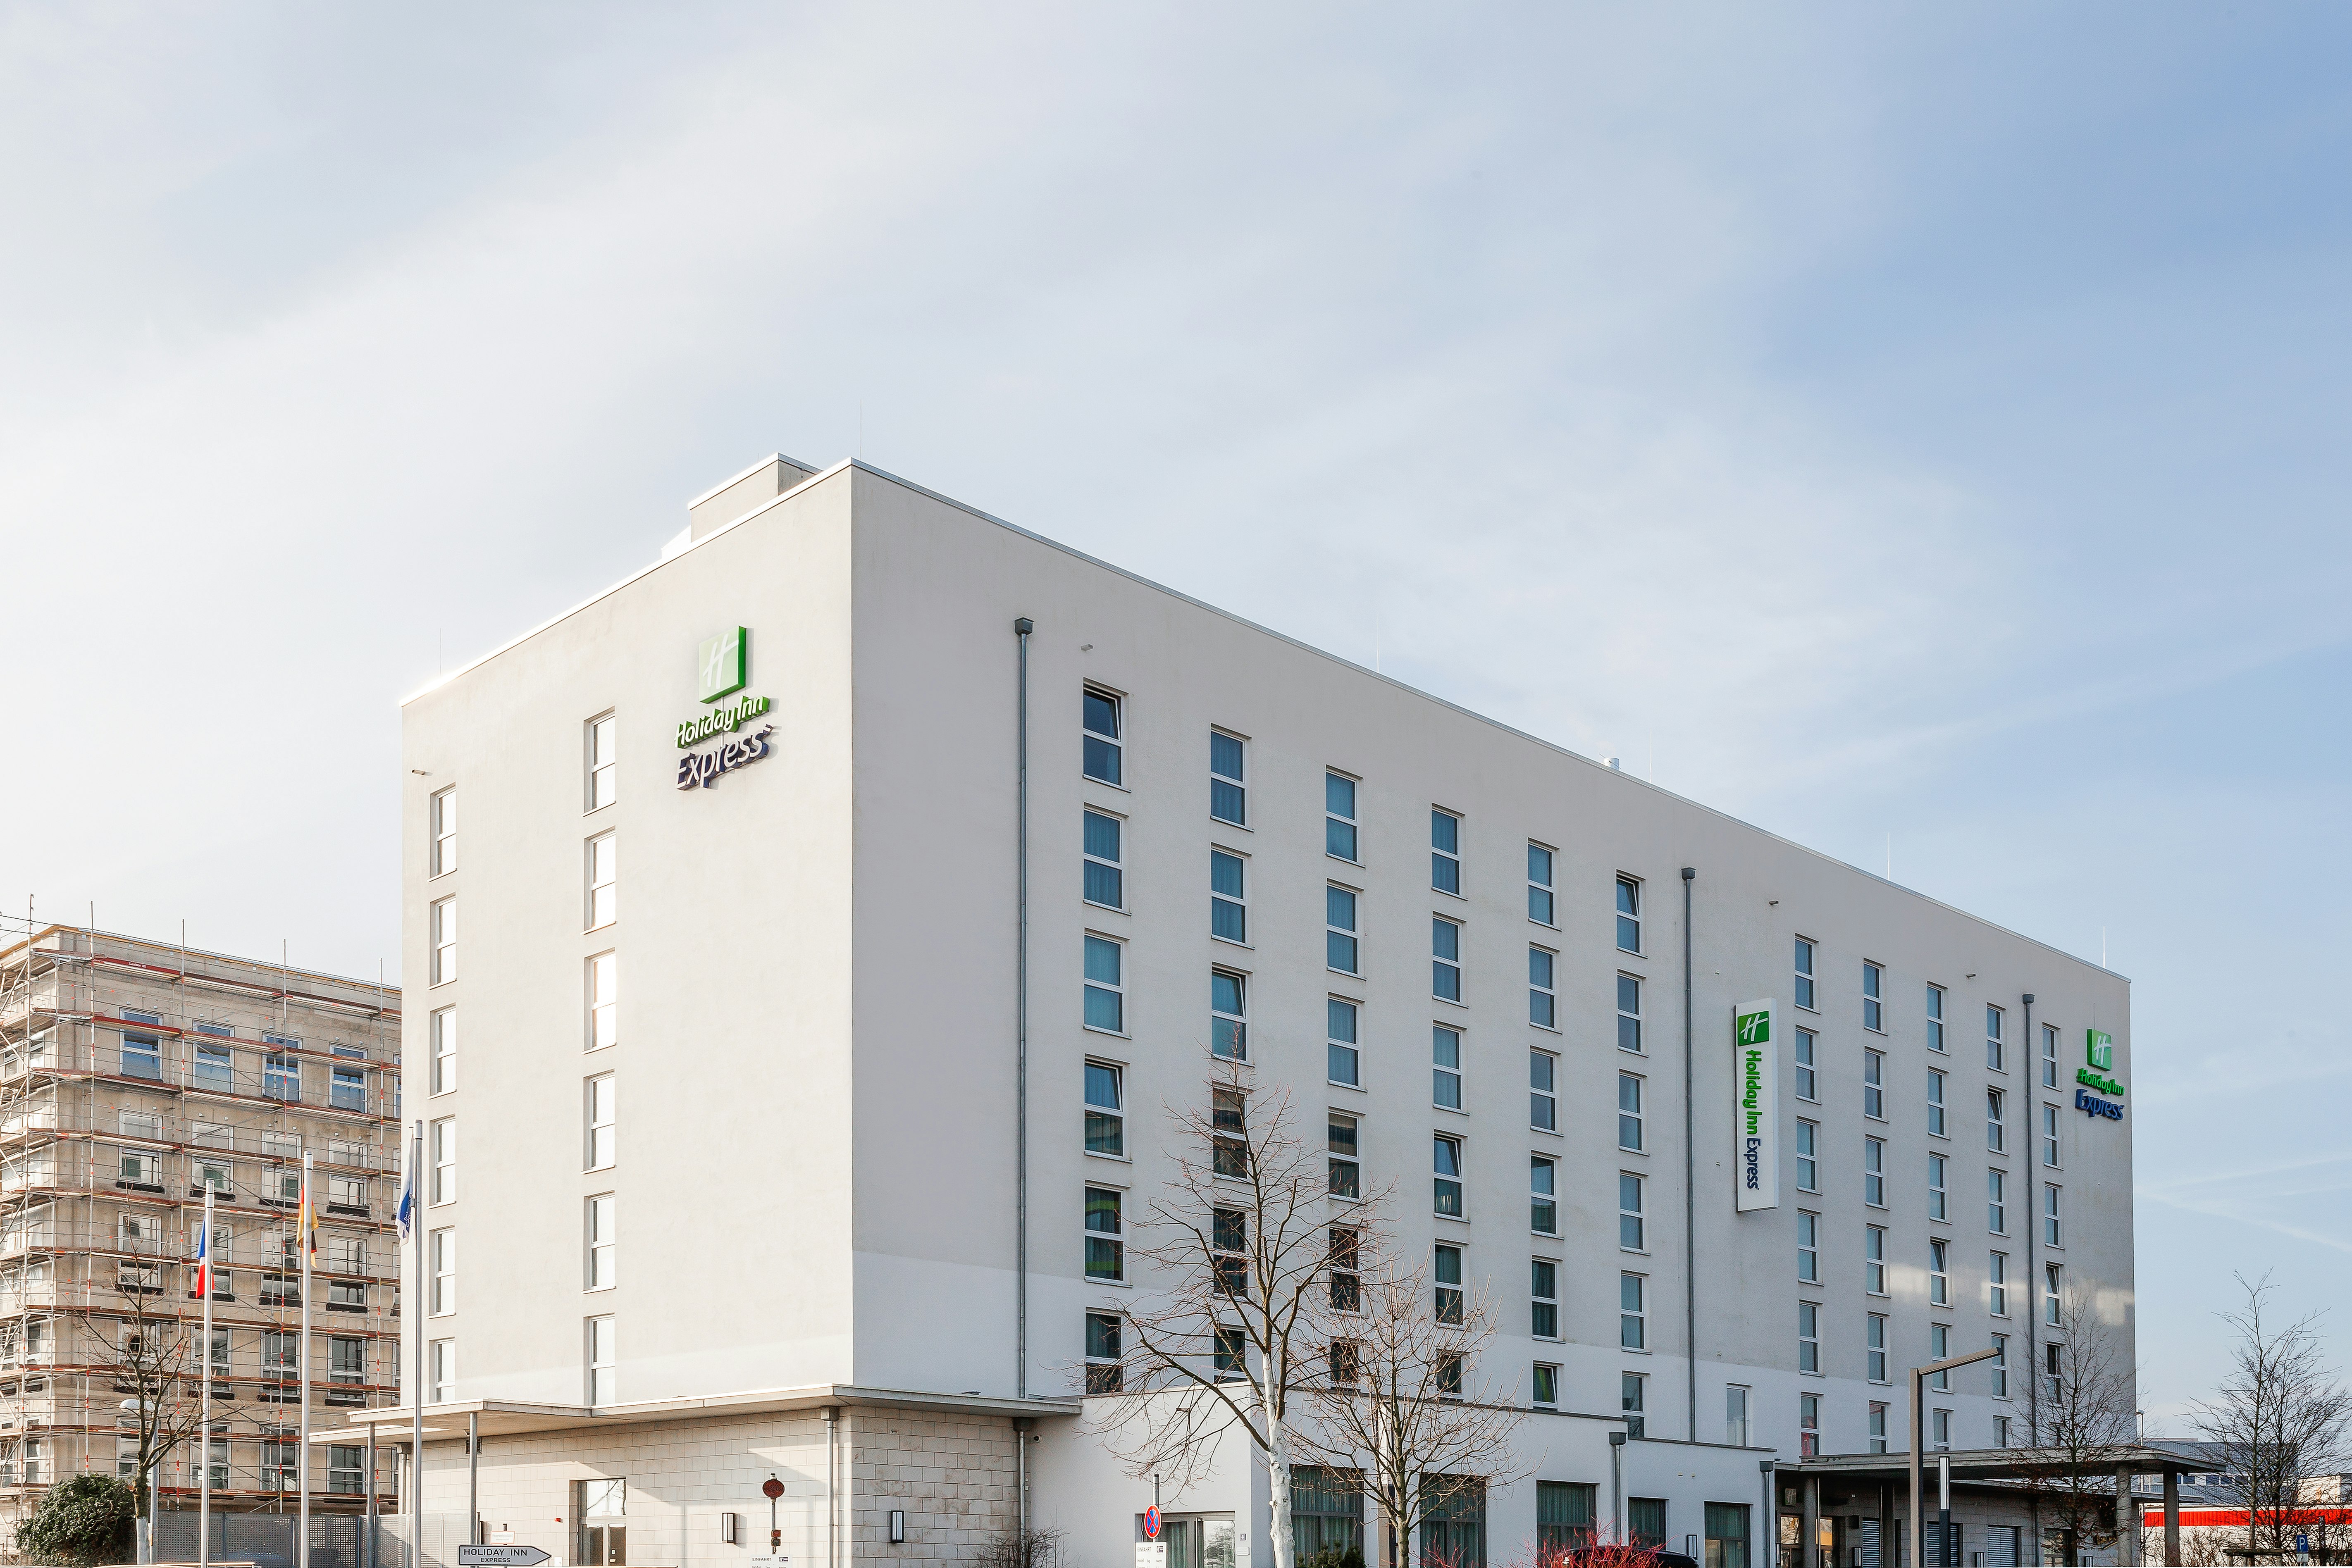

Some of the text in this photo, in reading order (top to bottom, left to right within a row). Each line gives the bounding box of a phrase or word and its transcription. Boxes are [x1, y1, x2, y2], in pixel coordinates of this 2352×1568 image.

[674, 695, 768, 748] Holiday Inn
[675, 726, 772, 790] Express
[2077, 1068, 2125, 1096] Holiday Inn
[1742, 1049, 1763, 1190] Holiday Inn Express
[2075, 1089, 2124, 1120] Express
[2300, 1537, 2305, 1550] P
